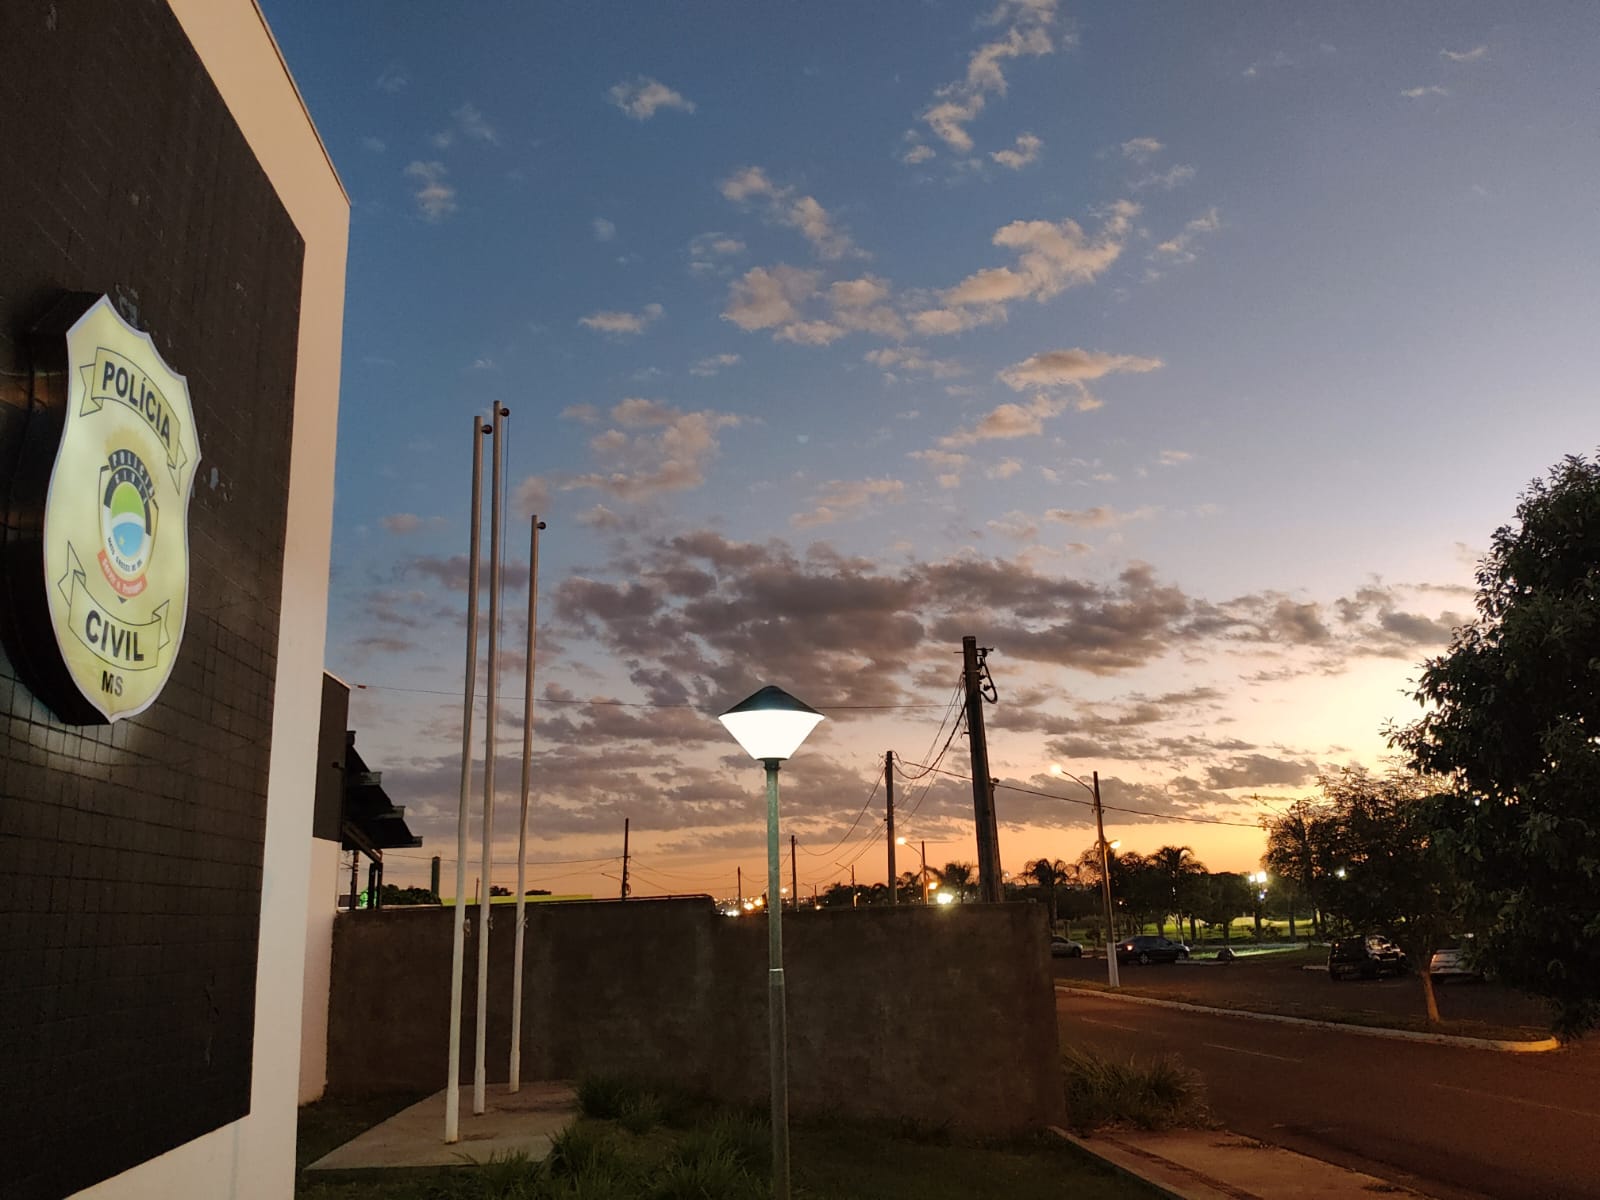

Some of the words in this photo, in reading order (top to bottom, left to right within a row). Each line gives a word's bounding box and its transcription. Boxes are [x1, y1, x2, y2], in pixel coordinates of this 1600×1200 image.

[102, 361, 171, 449] POLÍCIA
[85, 609, 145, 662] CIVIL
[101, 670, 124, 697] MS
